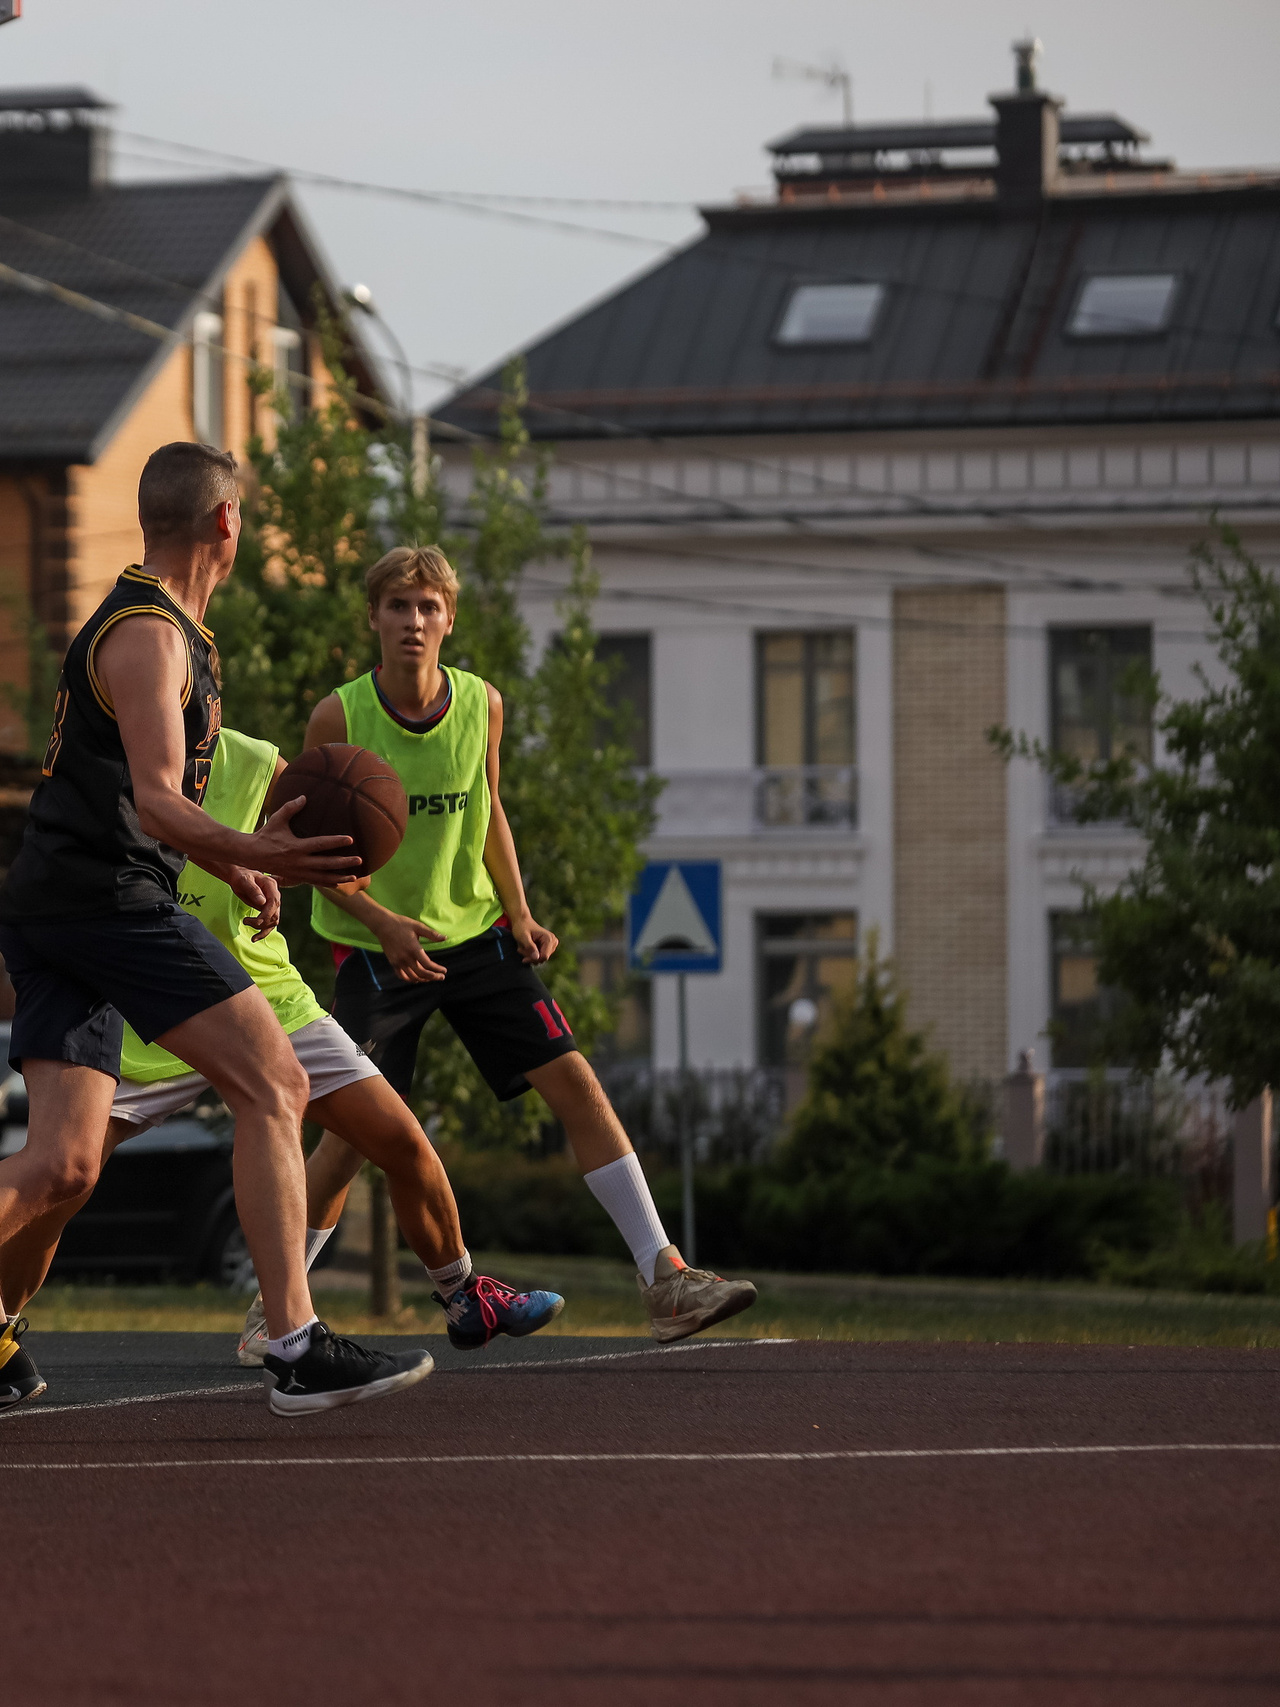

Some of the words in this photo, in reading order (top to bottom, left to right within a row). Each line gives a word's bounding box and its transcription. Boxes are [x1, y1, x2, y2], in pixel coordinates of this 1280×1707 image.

[408, 790, 468, 816] PSTa
[532, 999, 573, 1040] 1
[282, 1329, 309, 1350] PUMA
